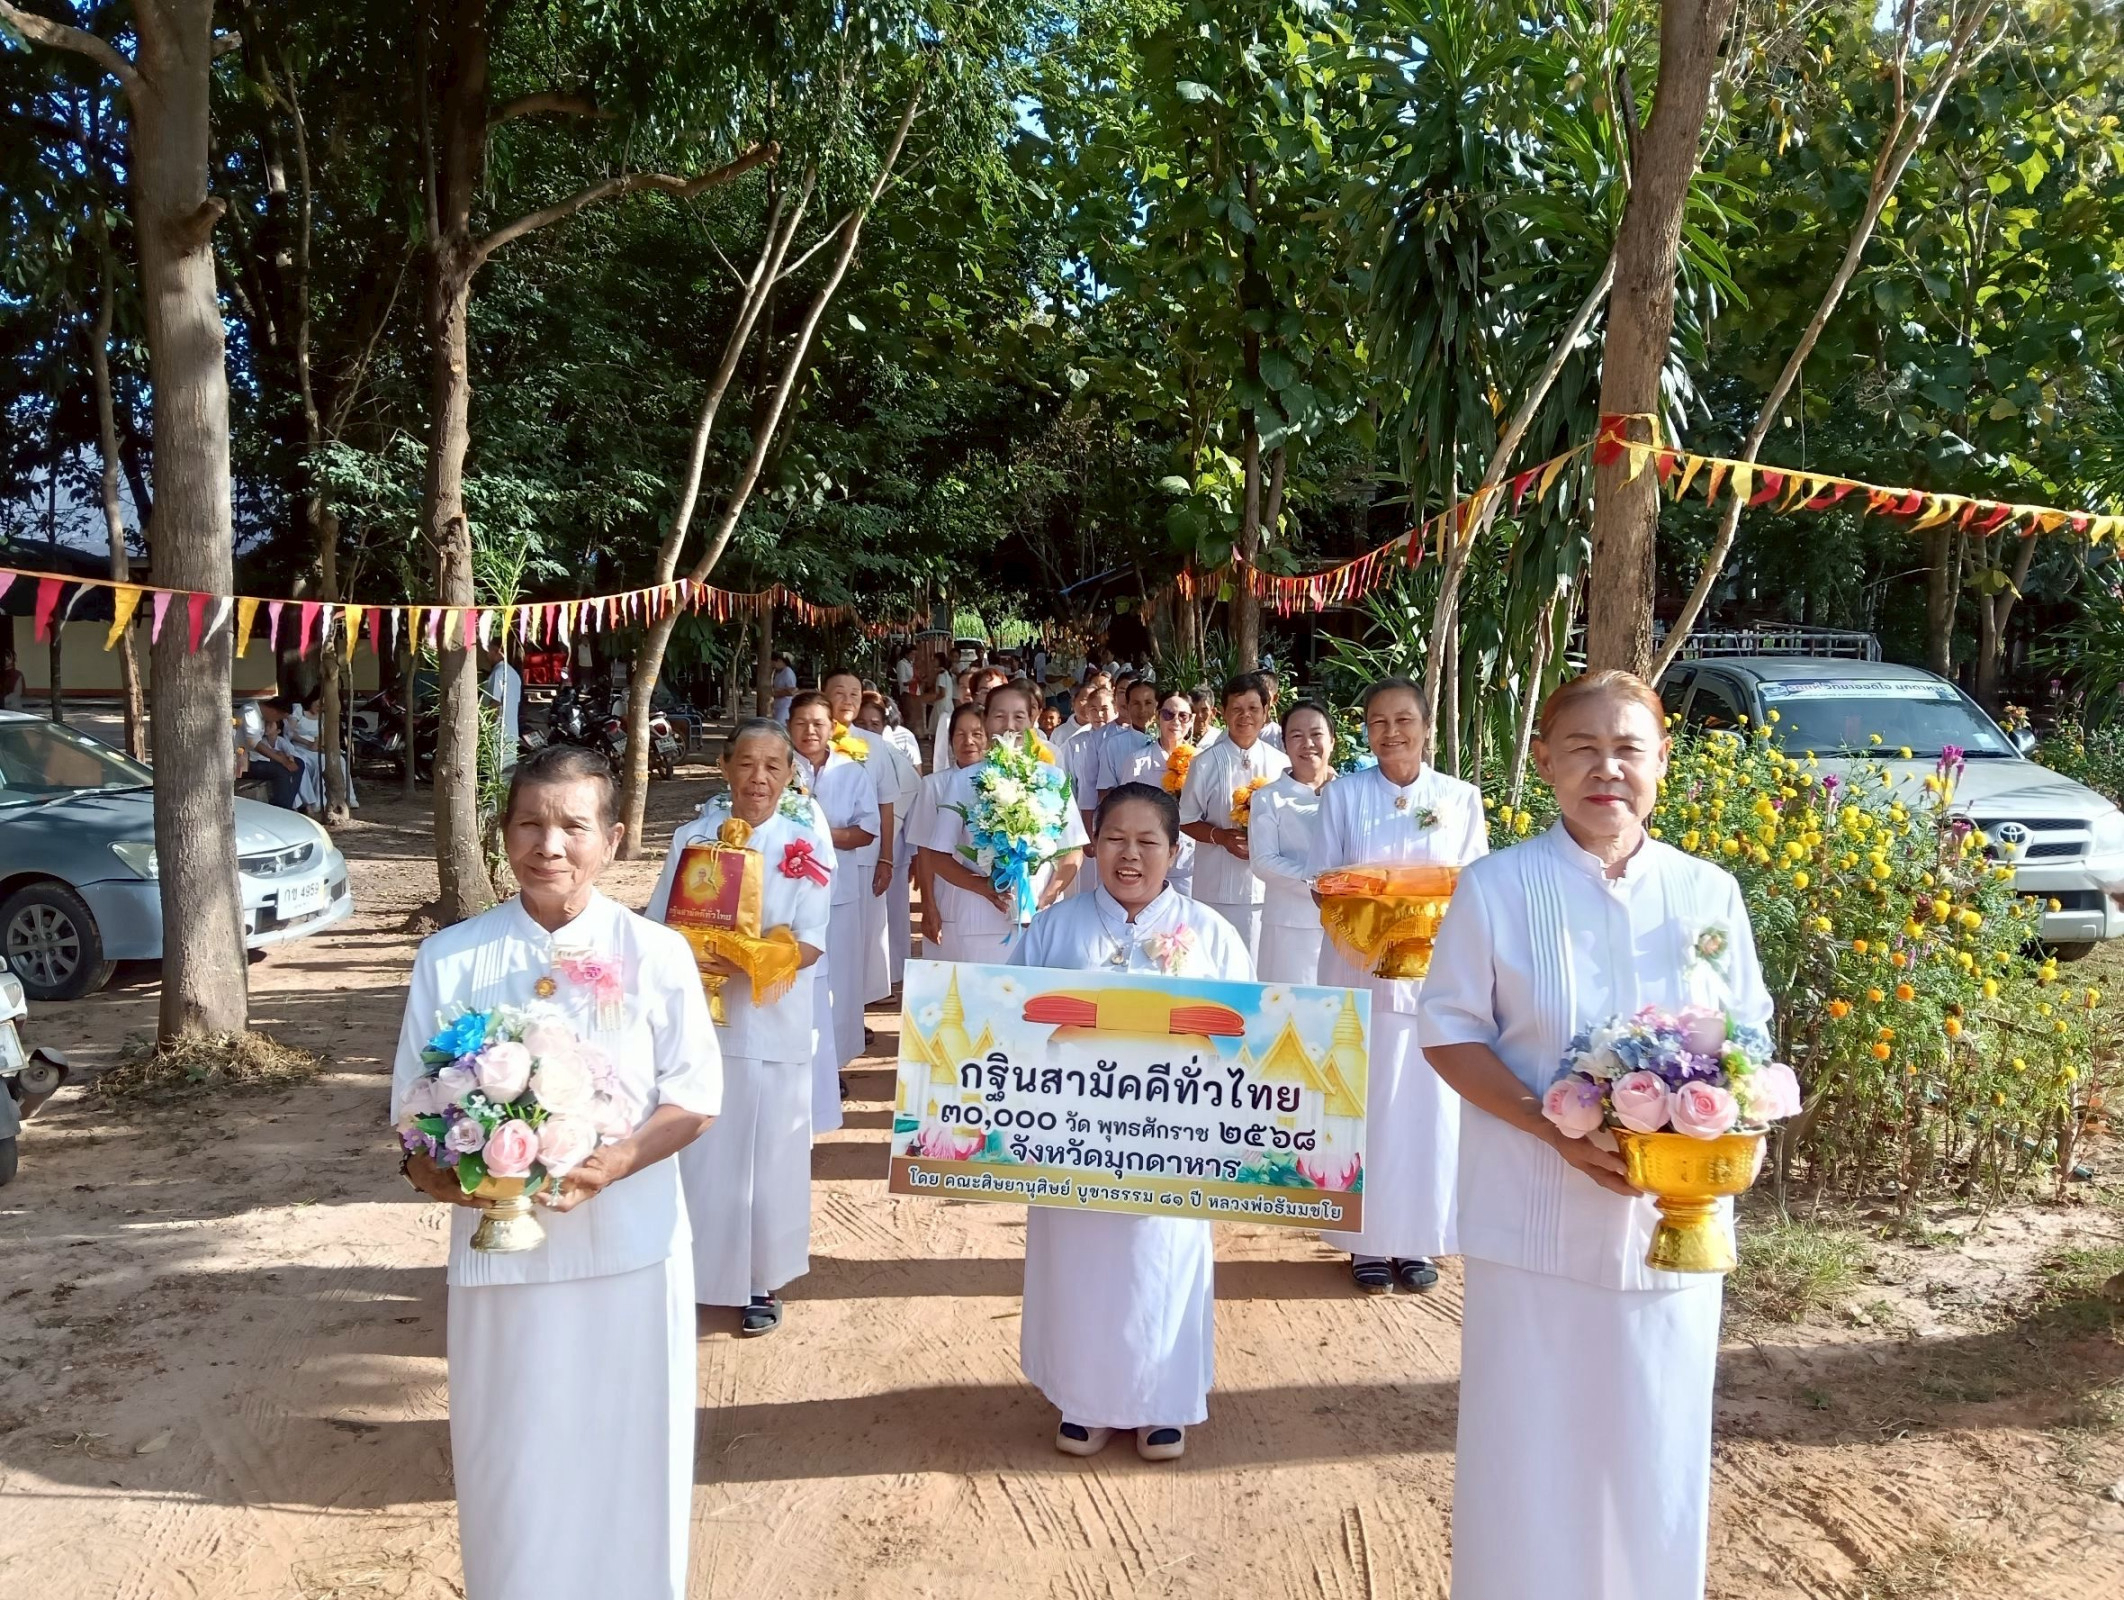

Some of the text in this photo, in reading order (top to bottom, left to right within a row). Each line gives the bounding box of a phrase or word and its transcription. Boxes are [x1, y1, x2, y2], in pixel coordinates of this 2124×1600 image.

[961, 1052, 1300, 1113] กฐินสามัคคีทั่วไทย
[941, 1104, 1316, 1151] ๓๐,๐๐๐ วัด พุทธศักราช ๒๕๖๘
[1010, 1133, 1242, 1180] จังหวัดมุกดาหาร
[909, 1167, 1341, 1219] โดย คณะศิษยานุศิษย์ บูชาธรรม ๘๑ ปี หลวงพ่อธัมมชโย
